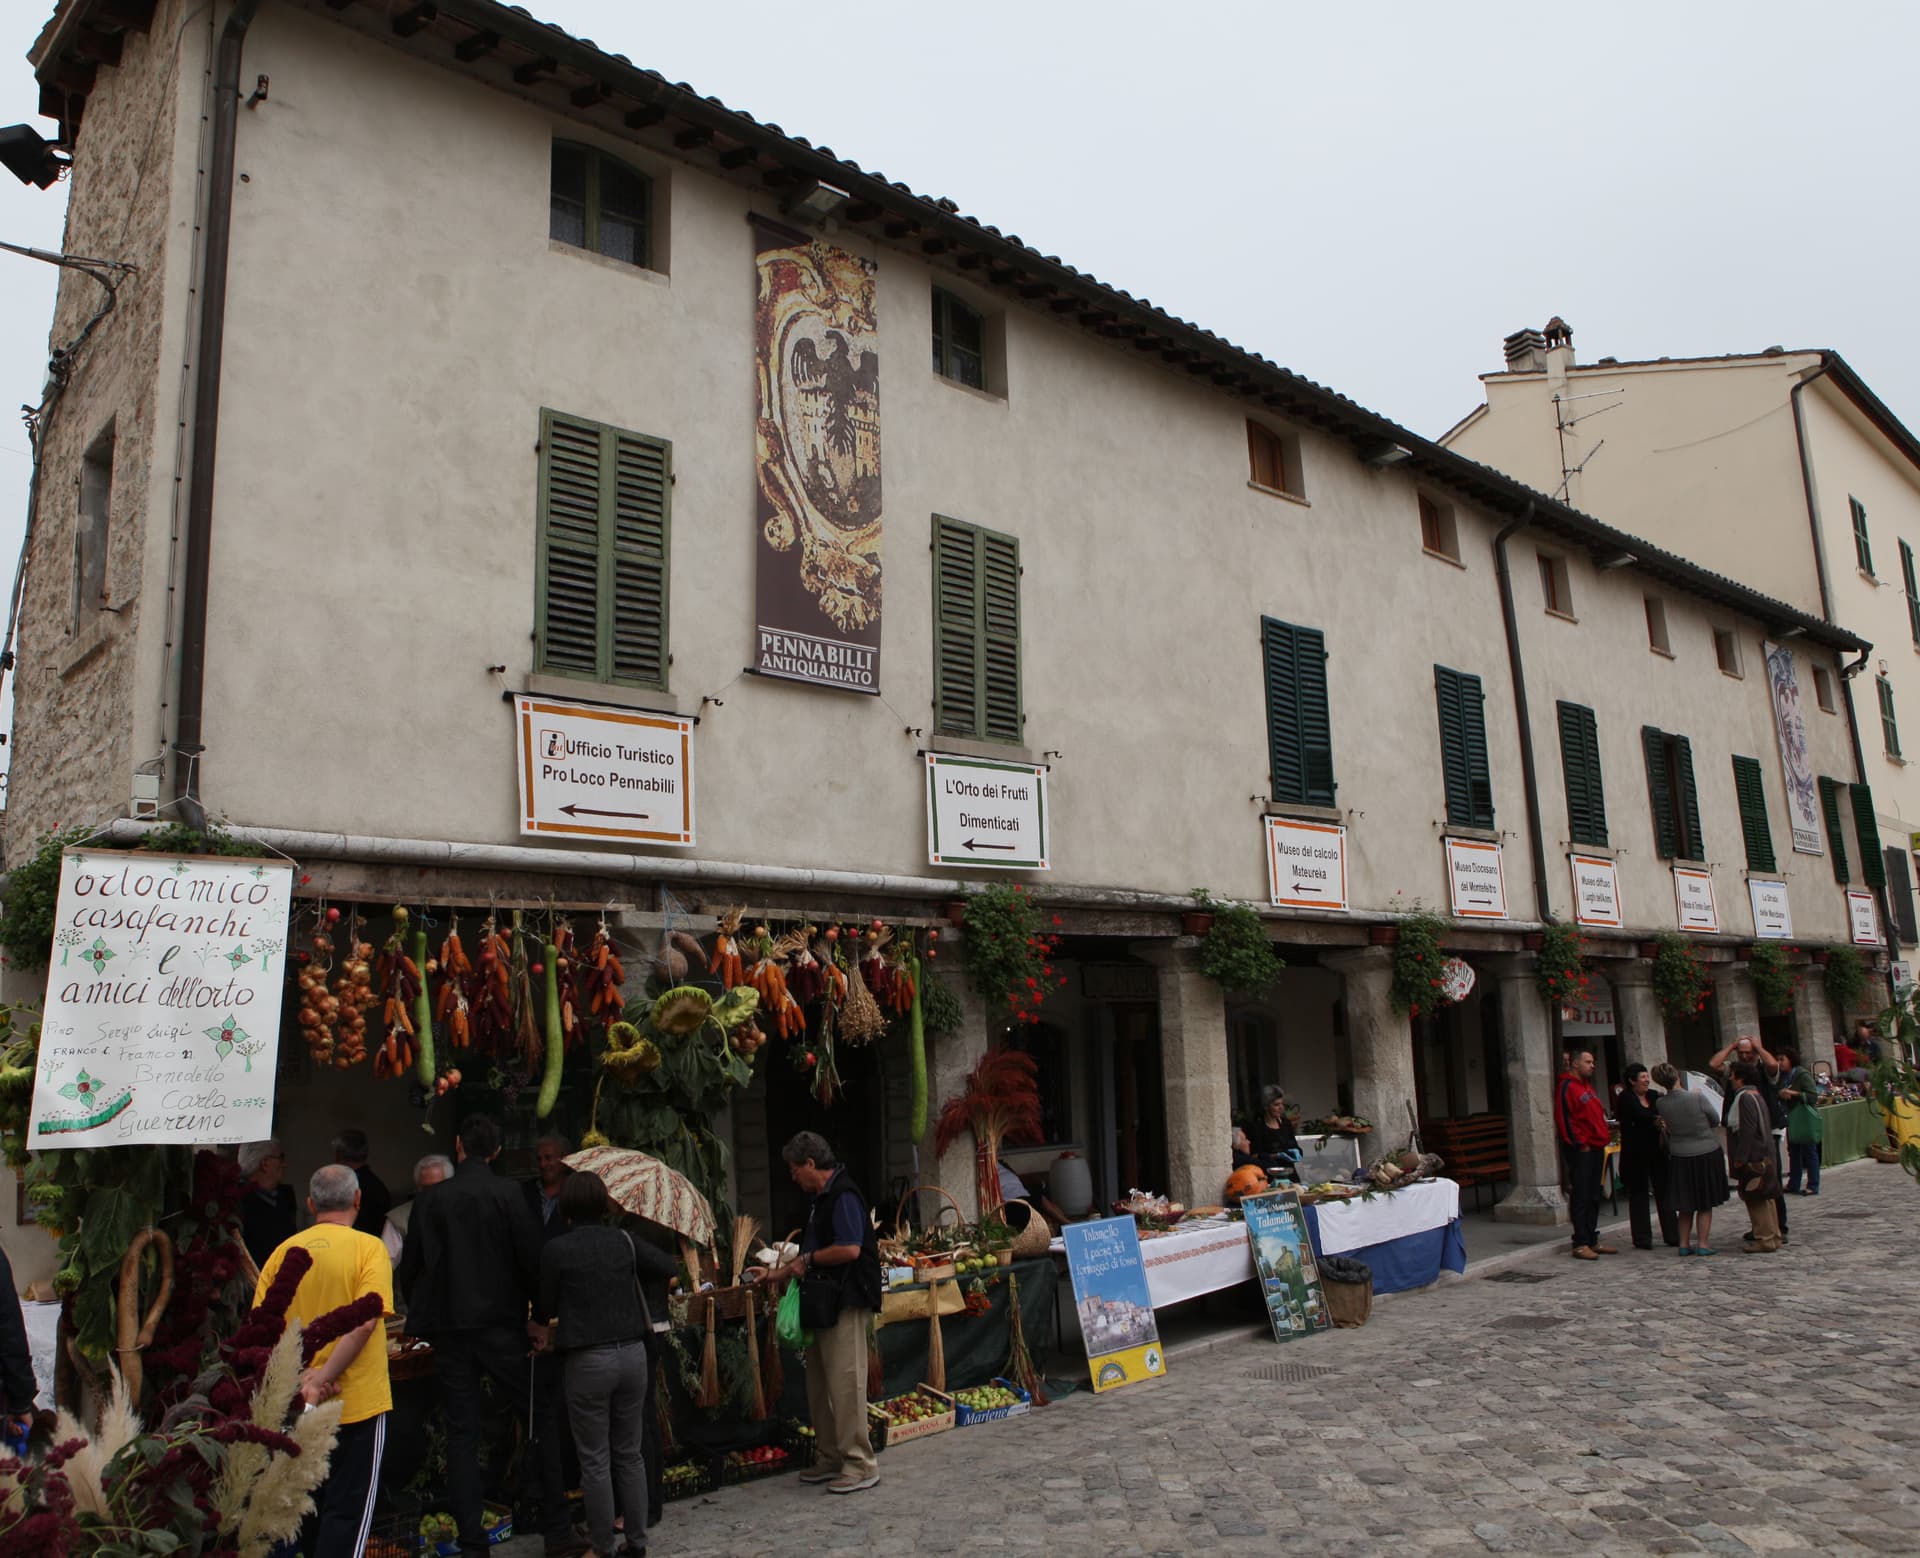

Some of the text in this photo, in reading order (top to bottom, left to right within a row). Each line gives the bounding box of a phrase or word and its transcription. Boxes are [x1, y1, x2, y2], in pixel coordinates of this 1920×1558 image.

[761, 632, 873, 670] PENNABILLI
[761, 653, 872, 685] ANTIQUARIATO
[565, 739, 612, 759] Ufficio
[616, 744, 675, 766] Turistico
[543, 764, 675, 795] Pro Loco Pennabilli
[945, 778, 1029, 801] L'Orto dei Frutti
[959, 812, 1020, 831] Dimenticati
[1277, 841, 1338, 860] Museo del calcolo
[1291, 863, 1327, 880] Mateureka
[60, 974, 254, 1009] amici dell'orto
[92, 1022, 142, 1044] Sergio
[52, 1046, 97, 1056] FRANCO
[119, 1044, 175, 1060] Franco
[132, 1064, 225, 1084] Benedetto
[161, 1087, 227, 1111] Carla
[1256, 1212, 1295, 1229] Talamello
[1081, 1224, 1120, 1242] Talamello
[963, 1408, 1008, 1426] Marlene
